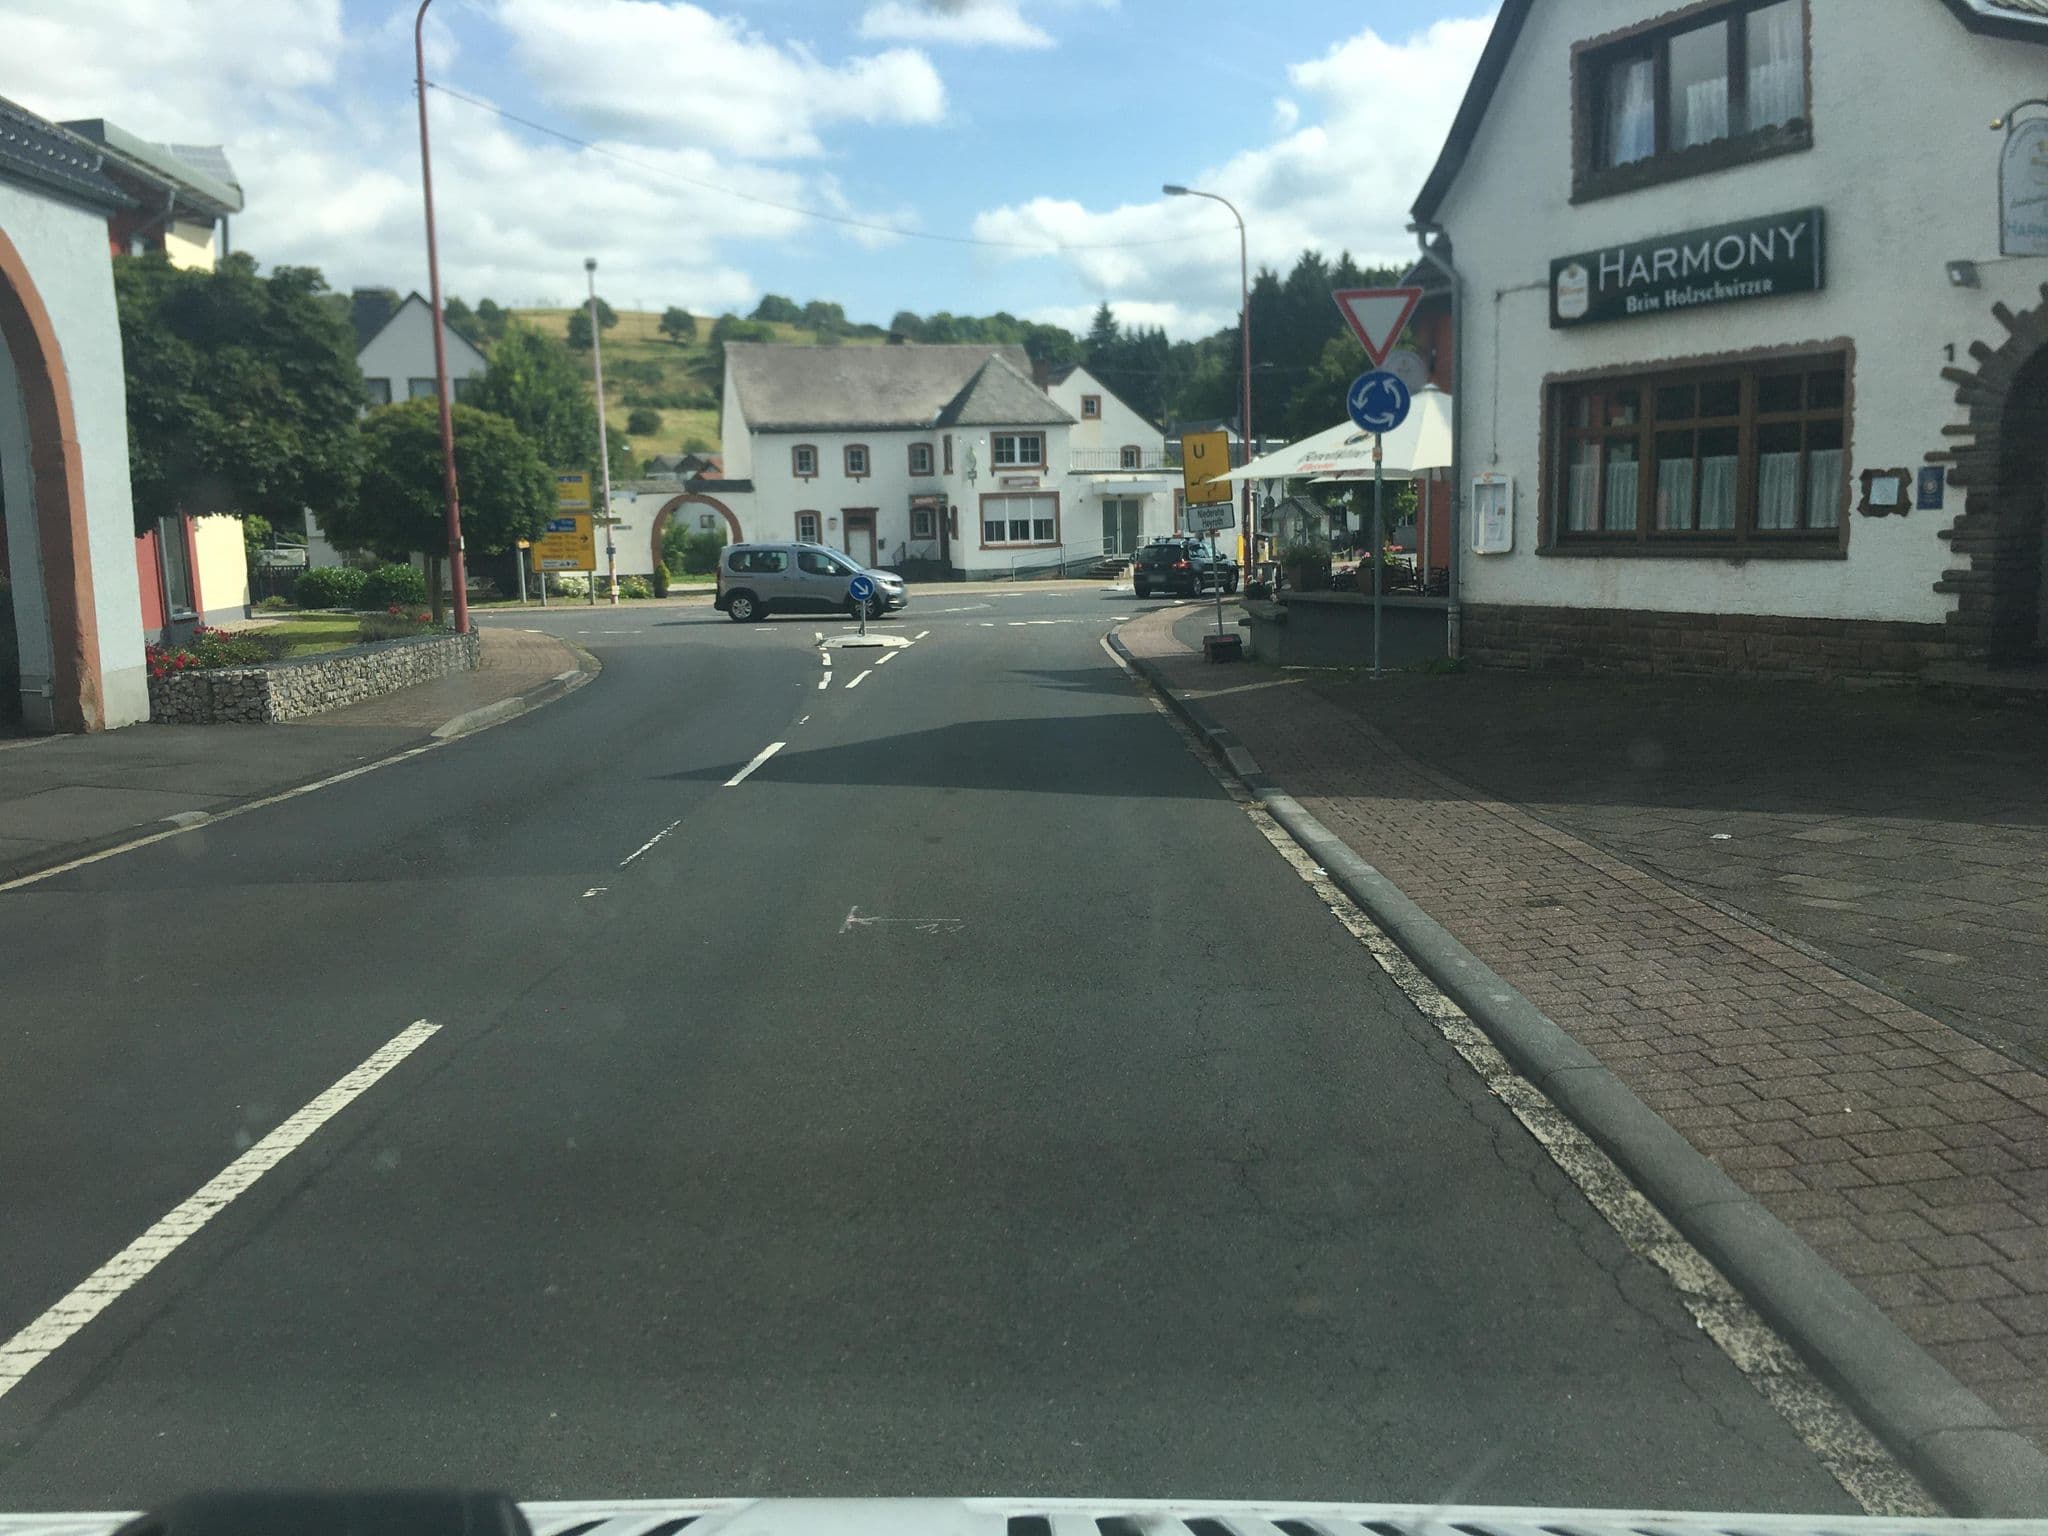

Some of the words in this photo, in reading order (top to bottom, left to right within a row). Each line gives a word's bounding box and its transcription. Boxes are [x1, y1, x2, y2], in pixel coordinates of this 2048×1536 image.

[1598, 222, 1807, 291] HARMONY
[1626, 294, 1660, 313] Beim
[1942, 343, 1955, 362] 1
[1193, 444, 1205, 458] U
